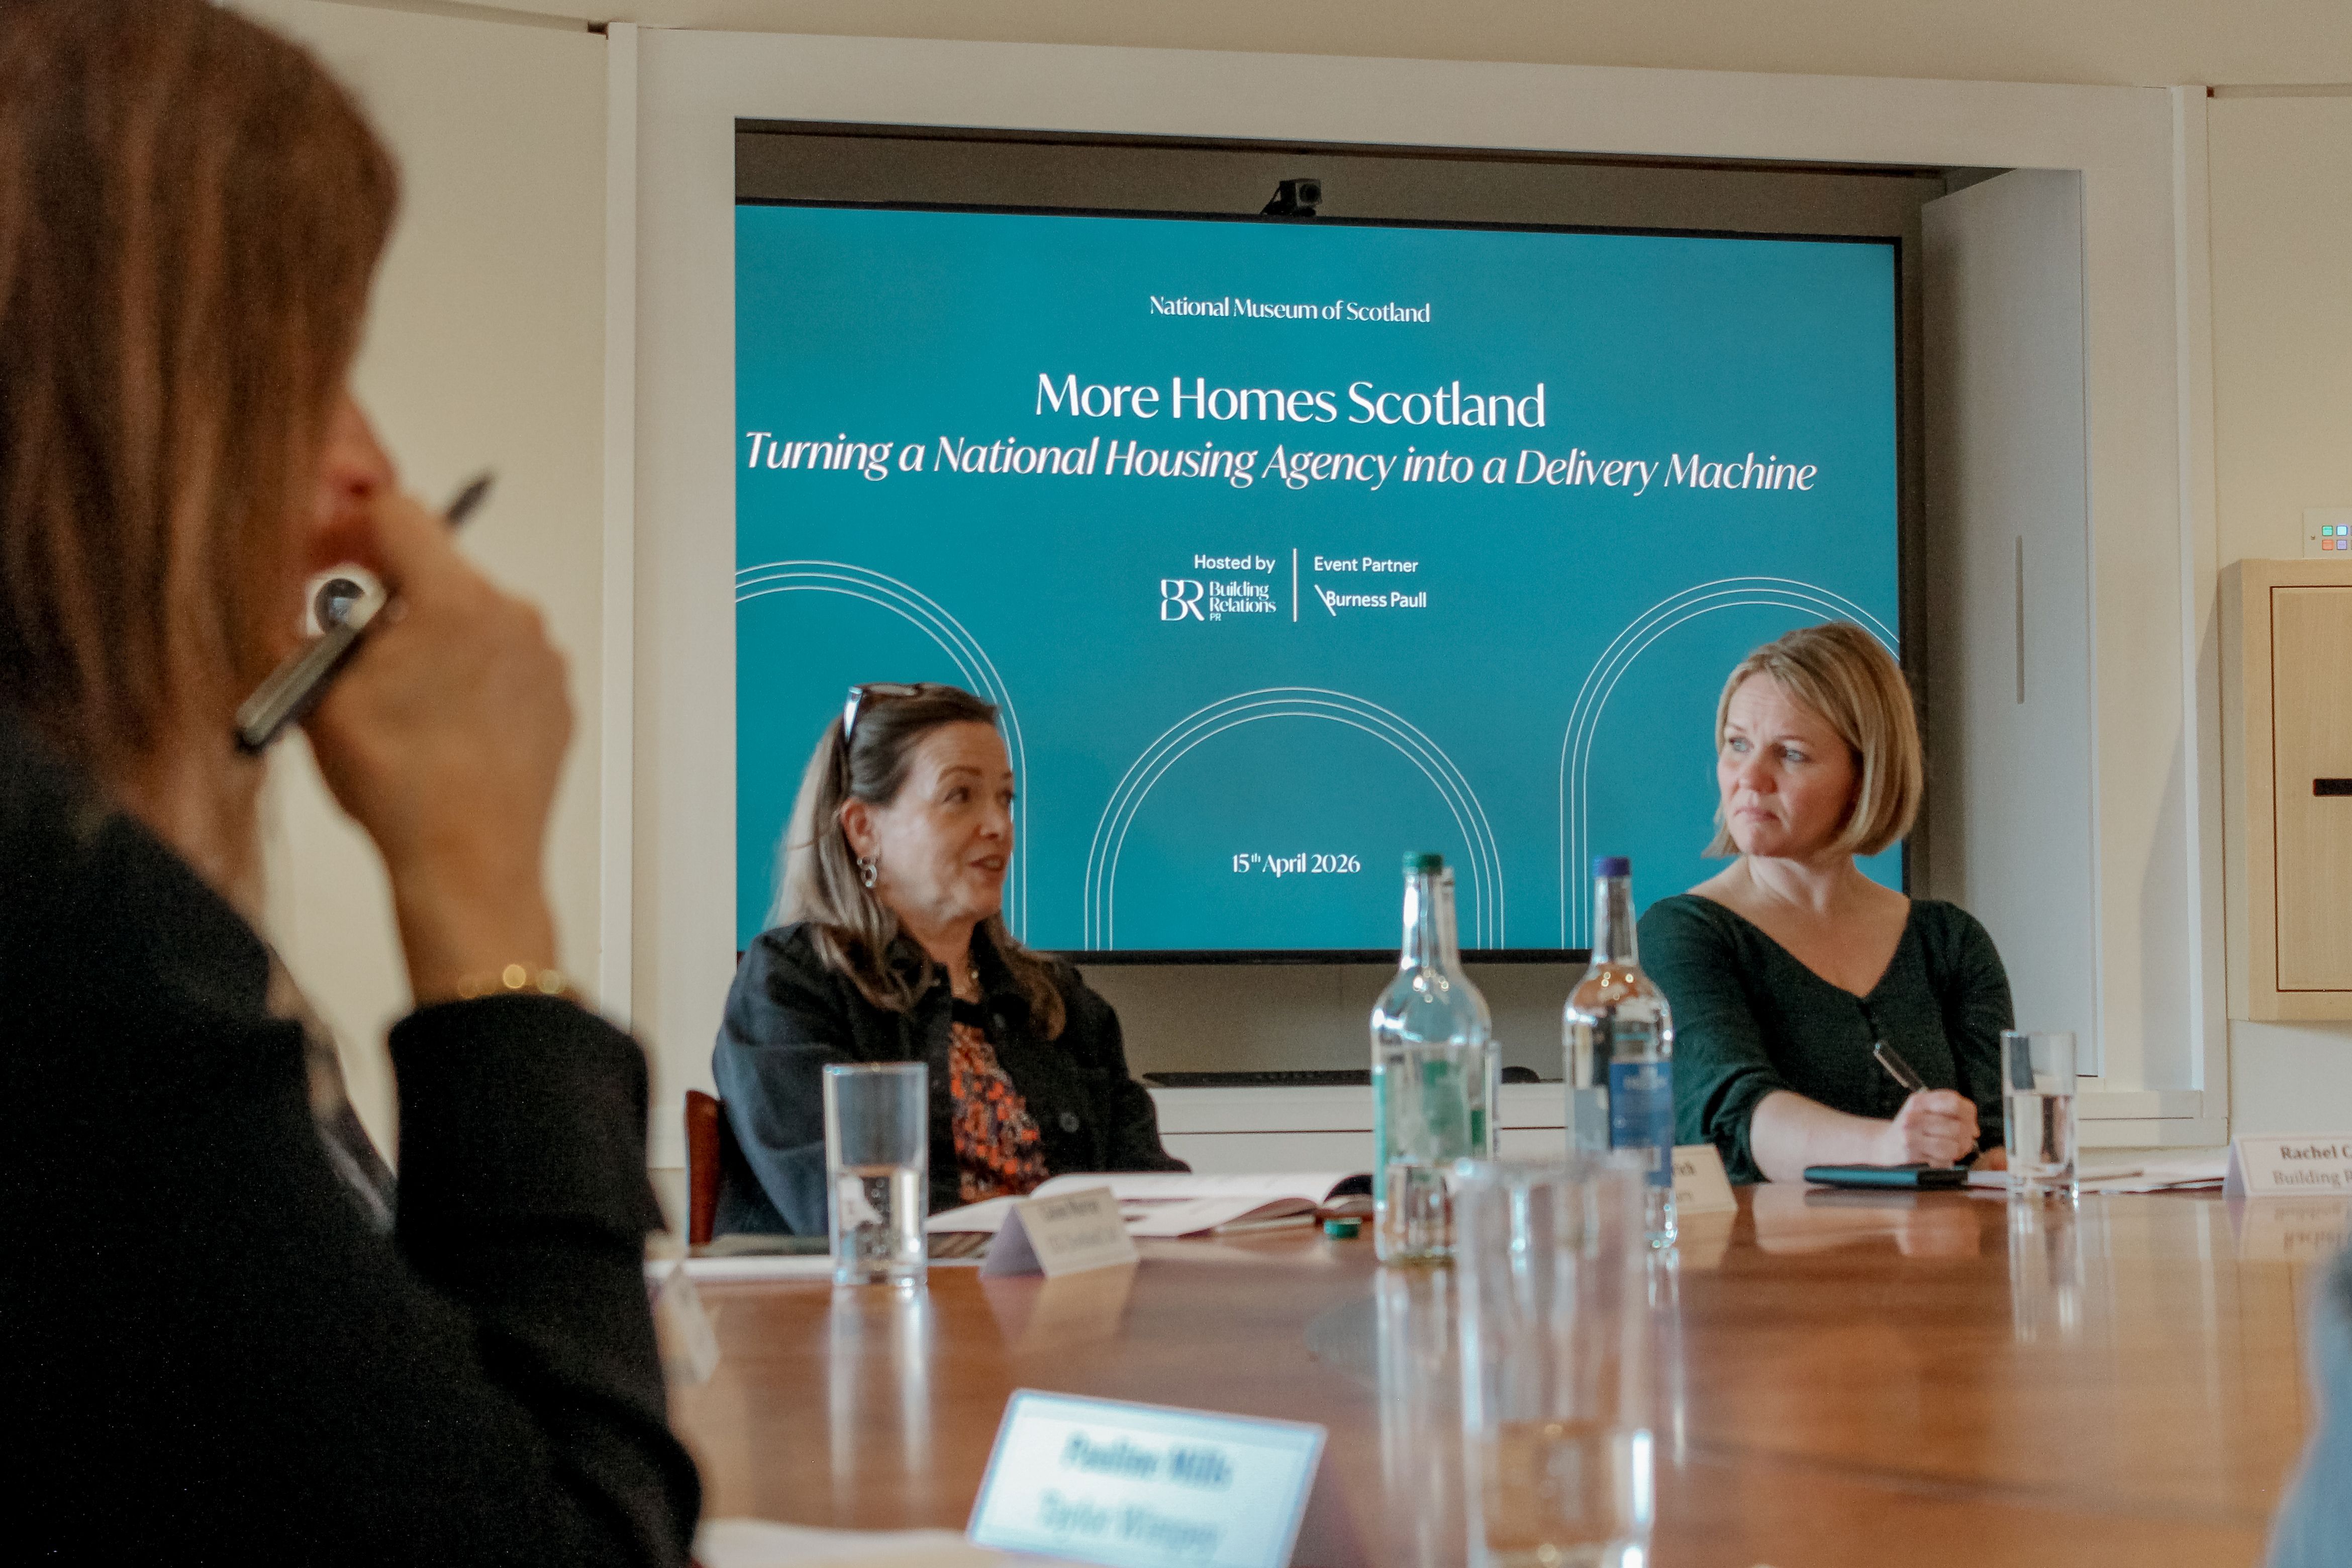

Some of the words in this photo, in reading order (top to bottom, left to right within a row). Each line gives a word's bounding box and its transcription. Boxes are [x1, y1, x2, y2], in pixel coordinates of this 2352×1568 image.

[1150, 296, 1229, 317] National
[1233, 298, 1318, 319] Museum
[1322, 300, 1343, 320] of
[1347, 302, 1430, 323] Scotland
[1036, 373, 1159, 418] More
[1172, 376, 1337, 423] Homes
[1348, 380, 1545, 428] Scotland
[746, 432, 894, 481] Turning
[898, 444, 925, 471] a
[934, 436, 1100, 475] National
[1105, 440, 1258, 488] Housing
[1261, 444, 1397, 491] Agency
[1403, 446, 1474, 483] into
[1482, 457, 1507, 484] a
[1515, 448, 1659, 497] Delivery
[1664, 452, 1818, 491] Machine
[1195, 554, 1251, 570] Hosted
[1255, 555, 1276, 574] by
[1314, 556, 1358, 571] Event
[1362, 557, 1419, 572] Partner
[1209, 581, 1269, 599] Building
[1209, 597, 1277, 613] Relations
[1328, 591, 1388, 608] Burness
[1391, 592, 1426, 608] Paull
[1233, 853, 1261, 872] 15th
[1262, 852, 1307, 878] April
[1311, 854, 1360, 873] 2026
[2280, 1143, 2337, 1159] Rachel
[2272, 1169, 2340, 1187] Building
